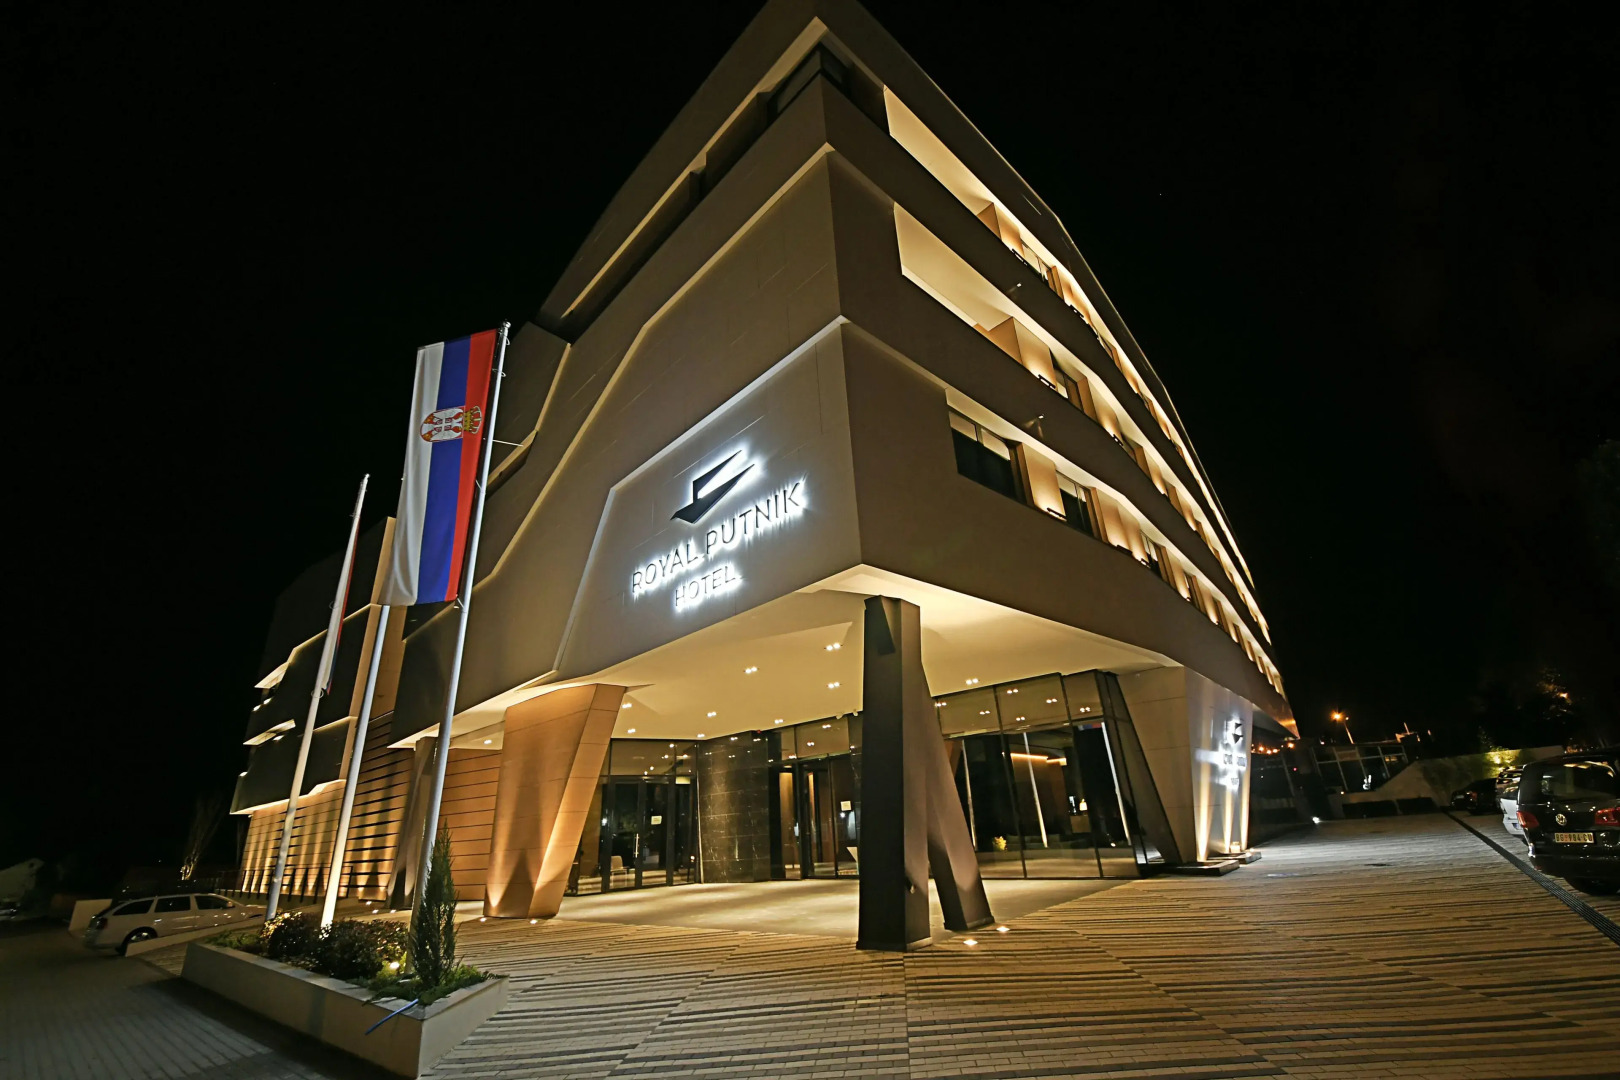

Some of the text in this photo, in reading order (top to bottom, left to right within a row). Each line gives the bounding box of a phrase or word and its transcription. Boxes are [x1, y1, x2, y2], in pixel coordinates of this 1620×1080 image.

[631, 481, 802, 594] ROYAL PUTNIK
[675, 565, 737, 607] HOTEL
